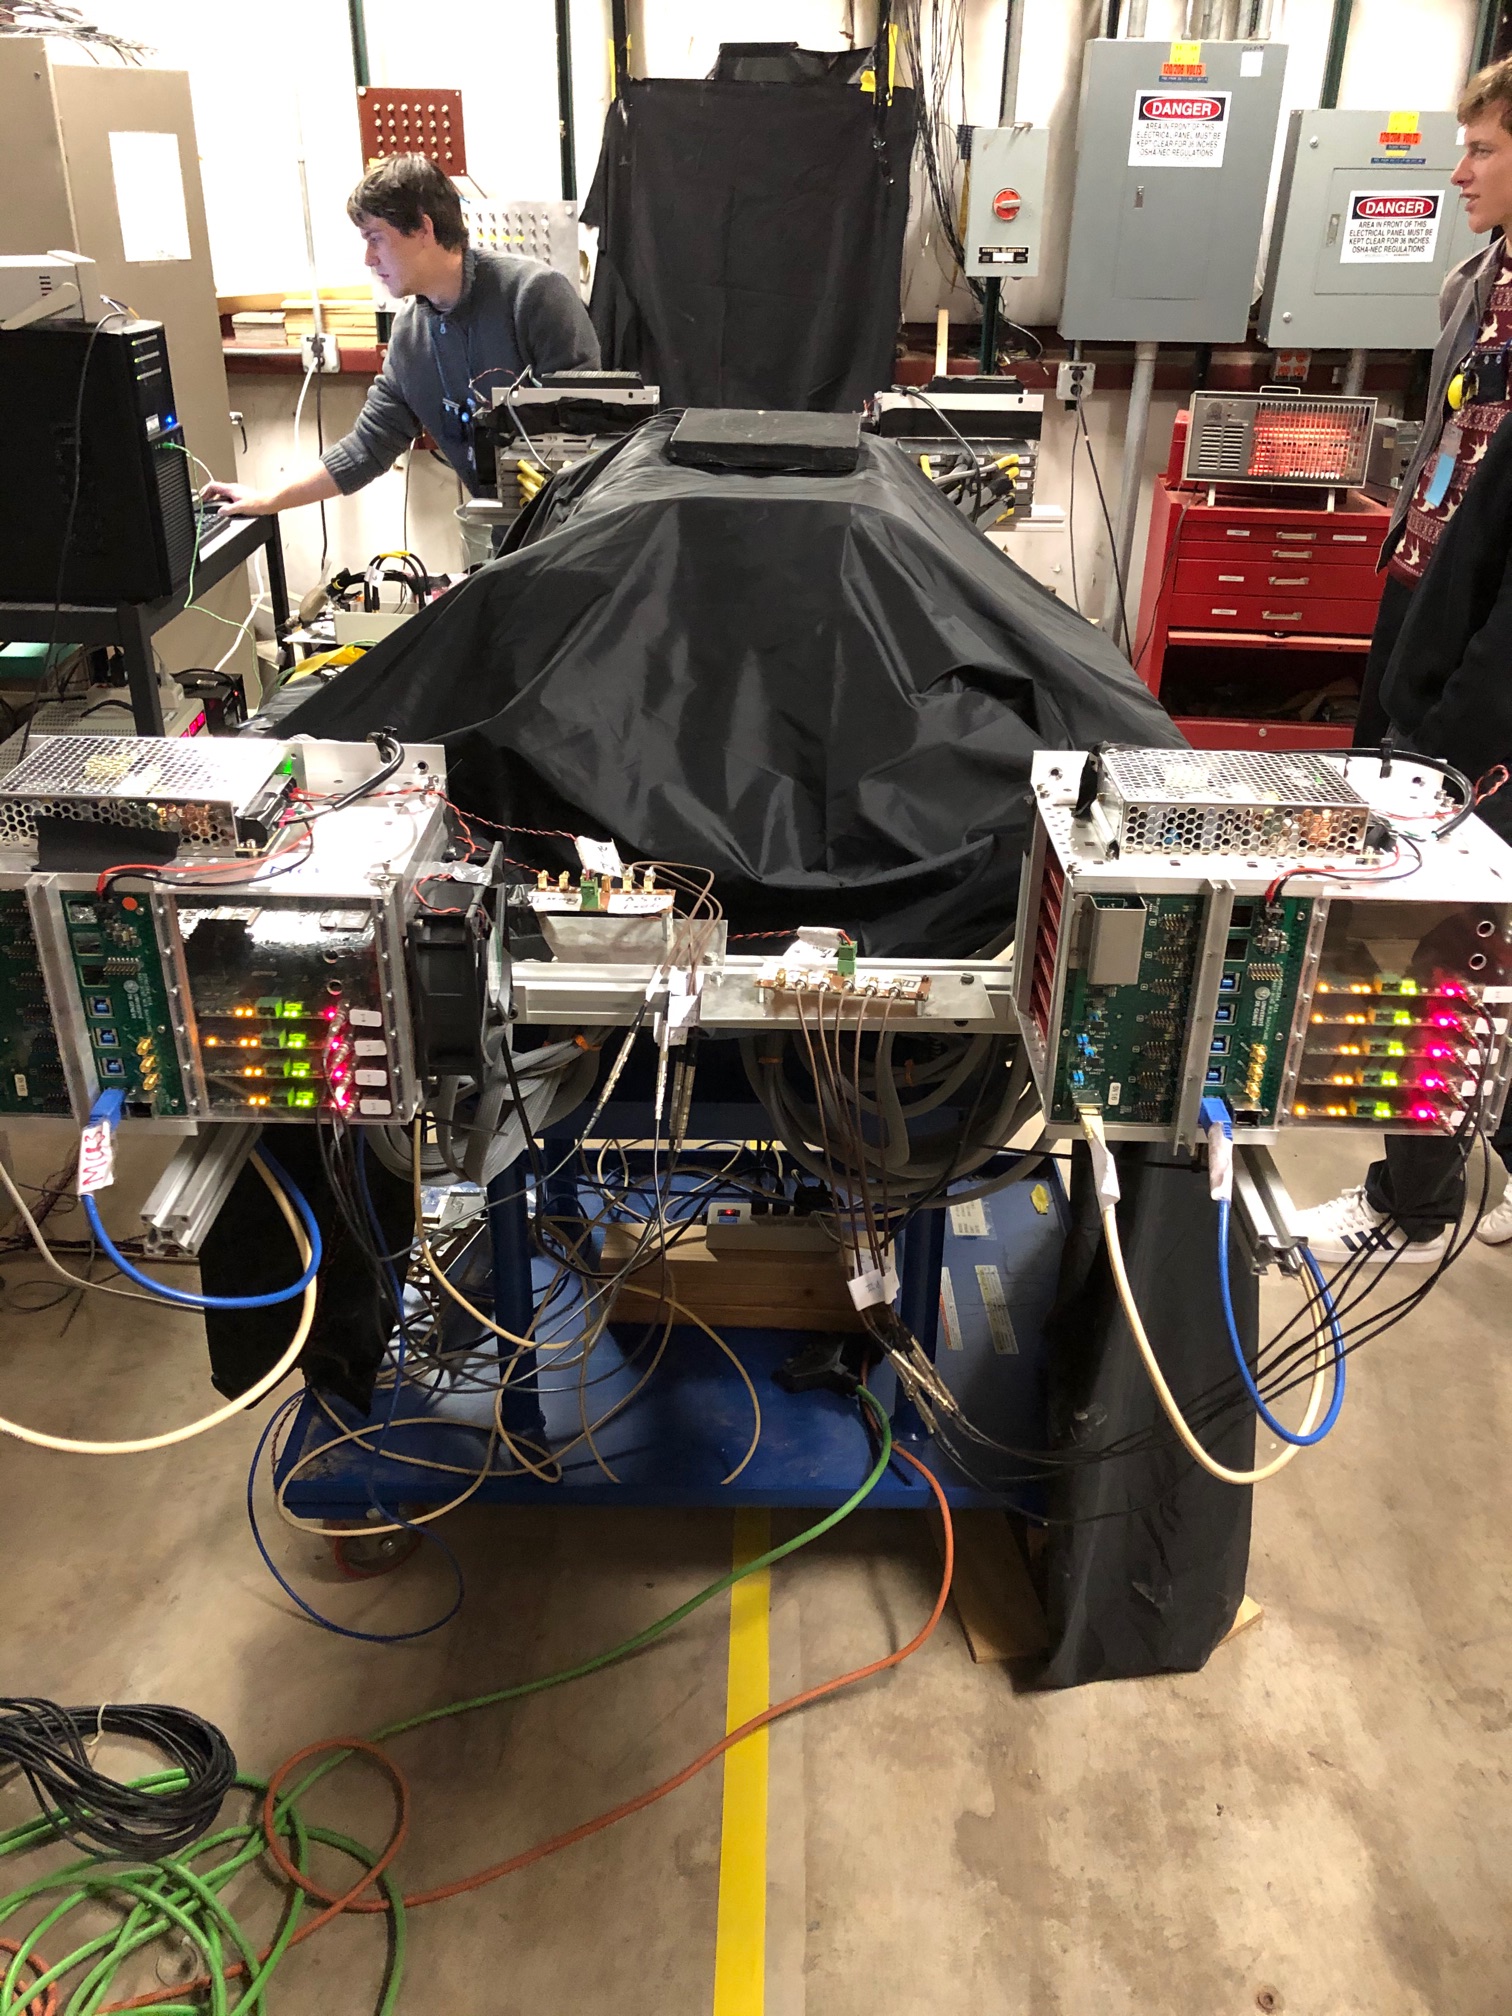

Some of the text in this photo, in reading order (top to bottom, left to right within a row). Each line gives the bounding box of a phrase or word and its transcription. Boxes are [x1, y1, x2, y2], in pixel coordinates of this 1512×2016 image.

[1186, 64, 1203, 76] VOLTS
[1151, 101, 1213, 116] DANGER
[1145, 122, 1215, 131] AREA IN FRONT OF THIS
[1136, 131, 1222, 140] ELECTRICAL PANEL MUST BE
[1136, 139, 1152, 148] KEPT
[1153, 139, 1174, 148] CLEAR
[1174, 140, 1187, 148] FOR
[1171, 149, 1214, 157] REGULATIONS
[1365, 201, 1425, 214] DANGER
[1358, 220, 1427, 229] AREA IN FRONT OF THIS
[1349, 228, 1433, 237] ELECTRICAL PANEL MUST BE
[1348, 237, 1365, 245] KEPT
[1365, 237, 1386, 245] CLEAR
[1386, 237, 1400, 245] FOR
[1400, 237, 1407, 245] 36
[1351, 245, 1425, 254] OSHA-NEC REGULATIONS
